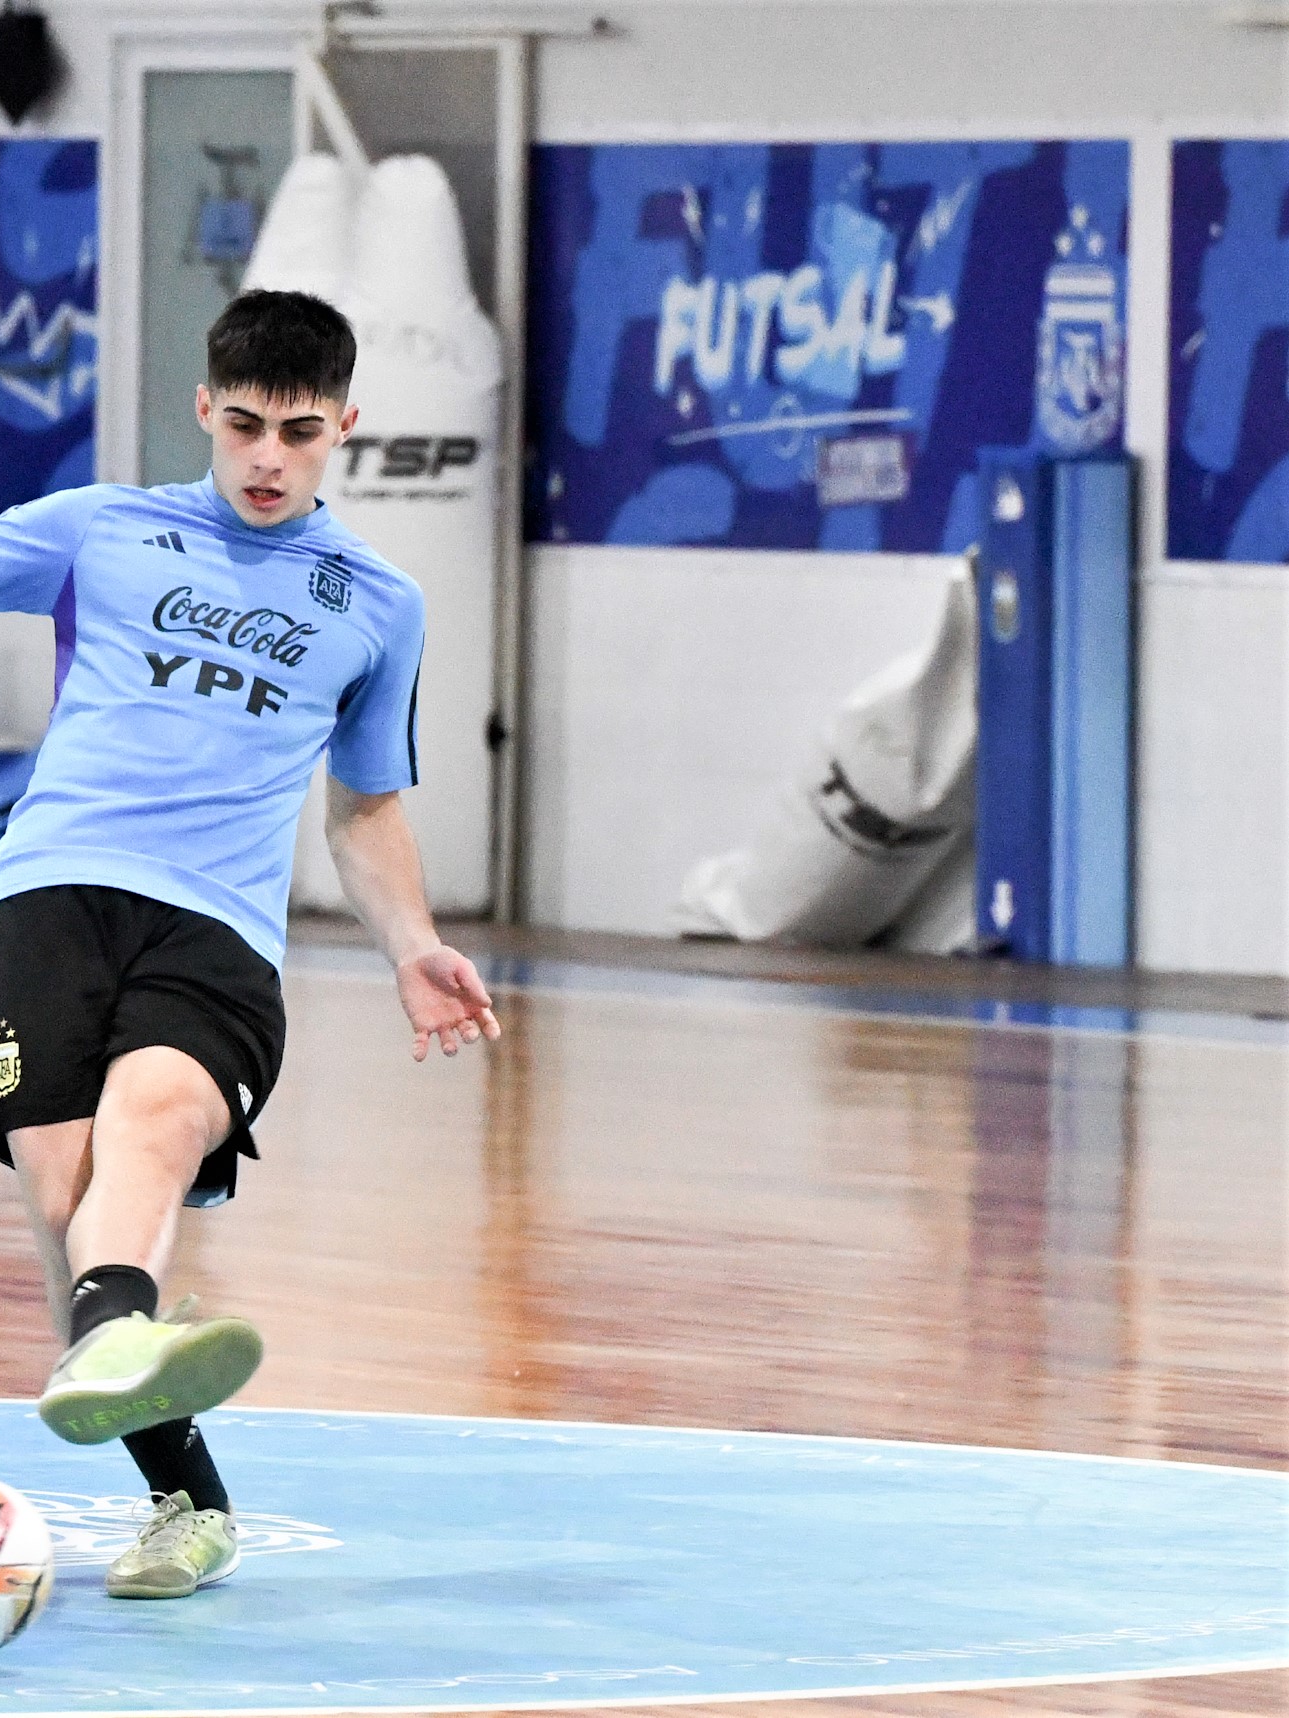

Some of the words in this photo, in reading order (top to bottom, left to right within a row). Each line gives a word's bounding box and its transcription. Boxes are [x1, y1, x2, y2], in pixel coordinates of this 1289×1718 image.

[653, 258, 906, 398] FUTSAL
[341, 436, 480, 478] TSP
[152, 586, 321, 668] Coca-Cola
[143, 651, 289, 718] YPF
